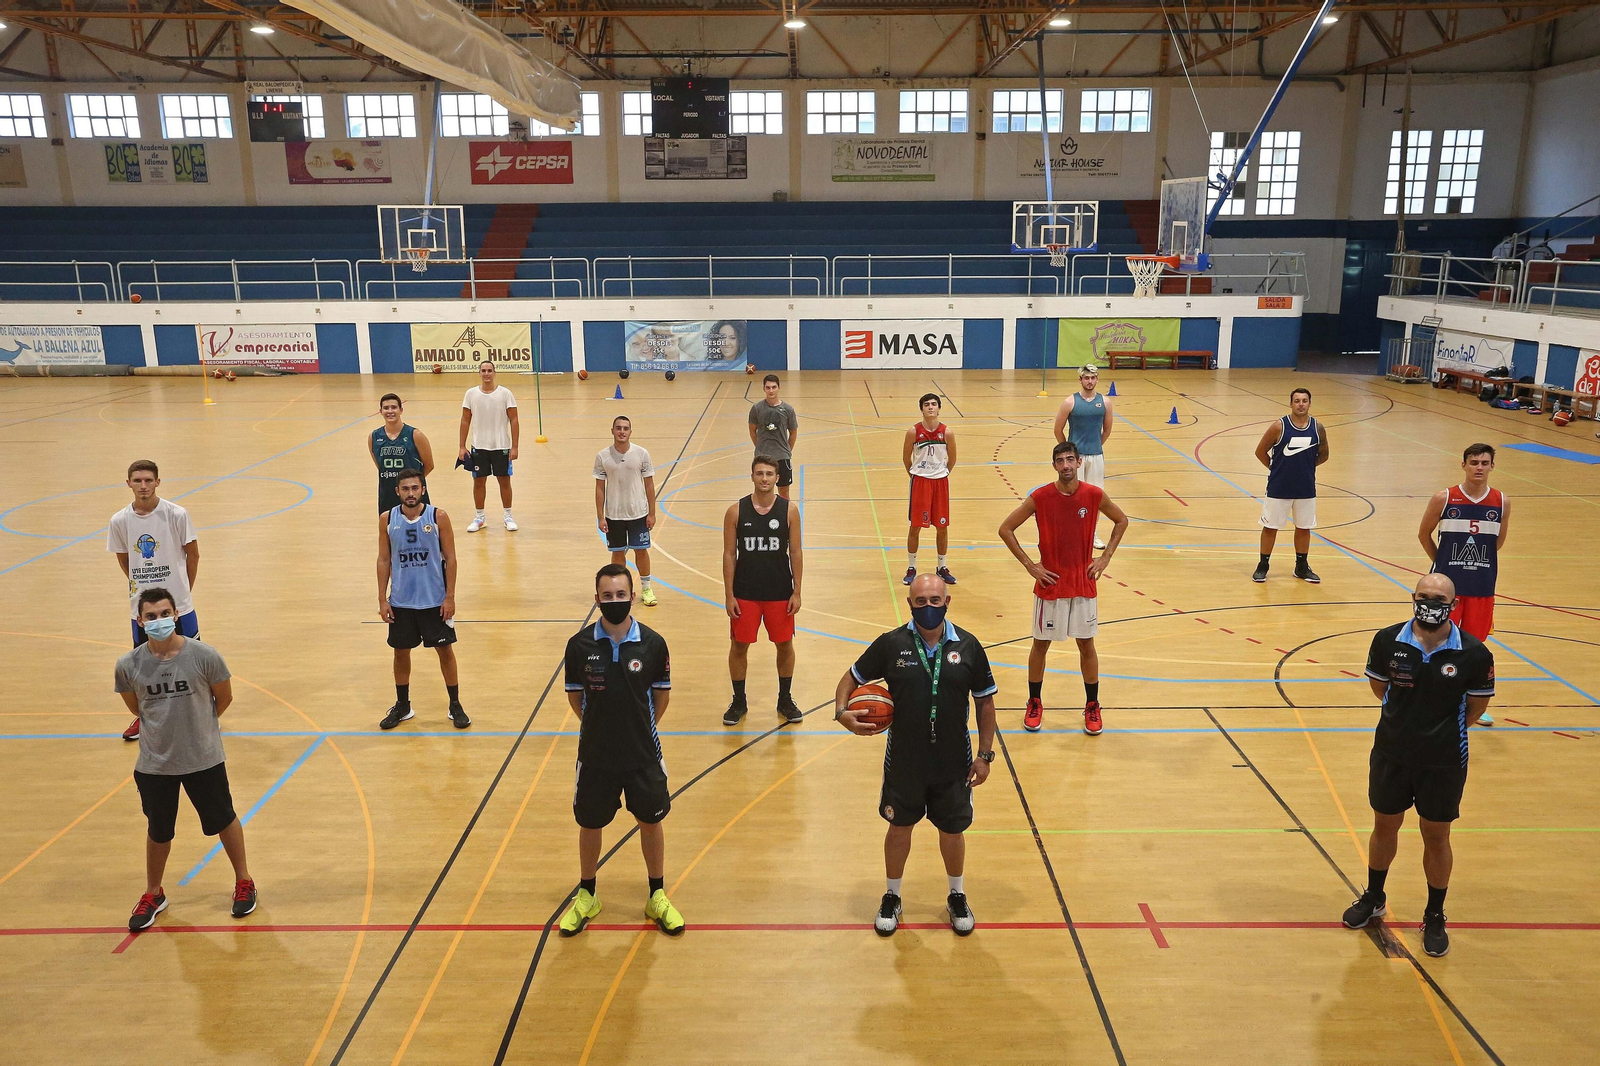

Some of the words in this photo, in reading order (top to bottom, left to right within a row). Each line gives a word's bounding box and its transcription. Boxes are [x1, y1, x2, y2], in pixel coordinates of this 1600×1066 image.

[104, 145, 125, 175] BC
[171, 145, 191, 175] BC
[856, 146, 928, 160] NOVODENTAL
[515, 156, 569, 169] CEPSA
[1070, 159, 1104, 168] HOUSE
[8, 327, 40, 336] AUTOLAVADO
[67, 327, 72, 336] DE
[74, 327, 100, 336] VEHICULOS
[33, 340, 43, 352] LA
[45, 340, 79, 352] BALLENA
[82, 340, 101, 352] AZUL
[235, 341, 314, 355] empresarial
[879, 333, 958, 355] MASA
[415, 349, 465, 362] AMADO
[473, 350, 480, 361] e
[488, 348, 530, 361] HIJOS
[1579, 378, 1593, 394] de
[384, 459, 404, 468] 00
[1469, 520, 1479, 535] 5
[406, 529, 417, 543] 5
[744, 537, 779, 551] ULB
[399, 552, 429, 563] DKV
[133, 571, 171, 579] CHAMPIONSHIP
[147, 680, 189, 695] ULB
